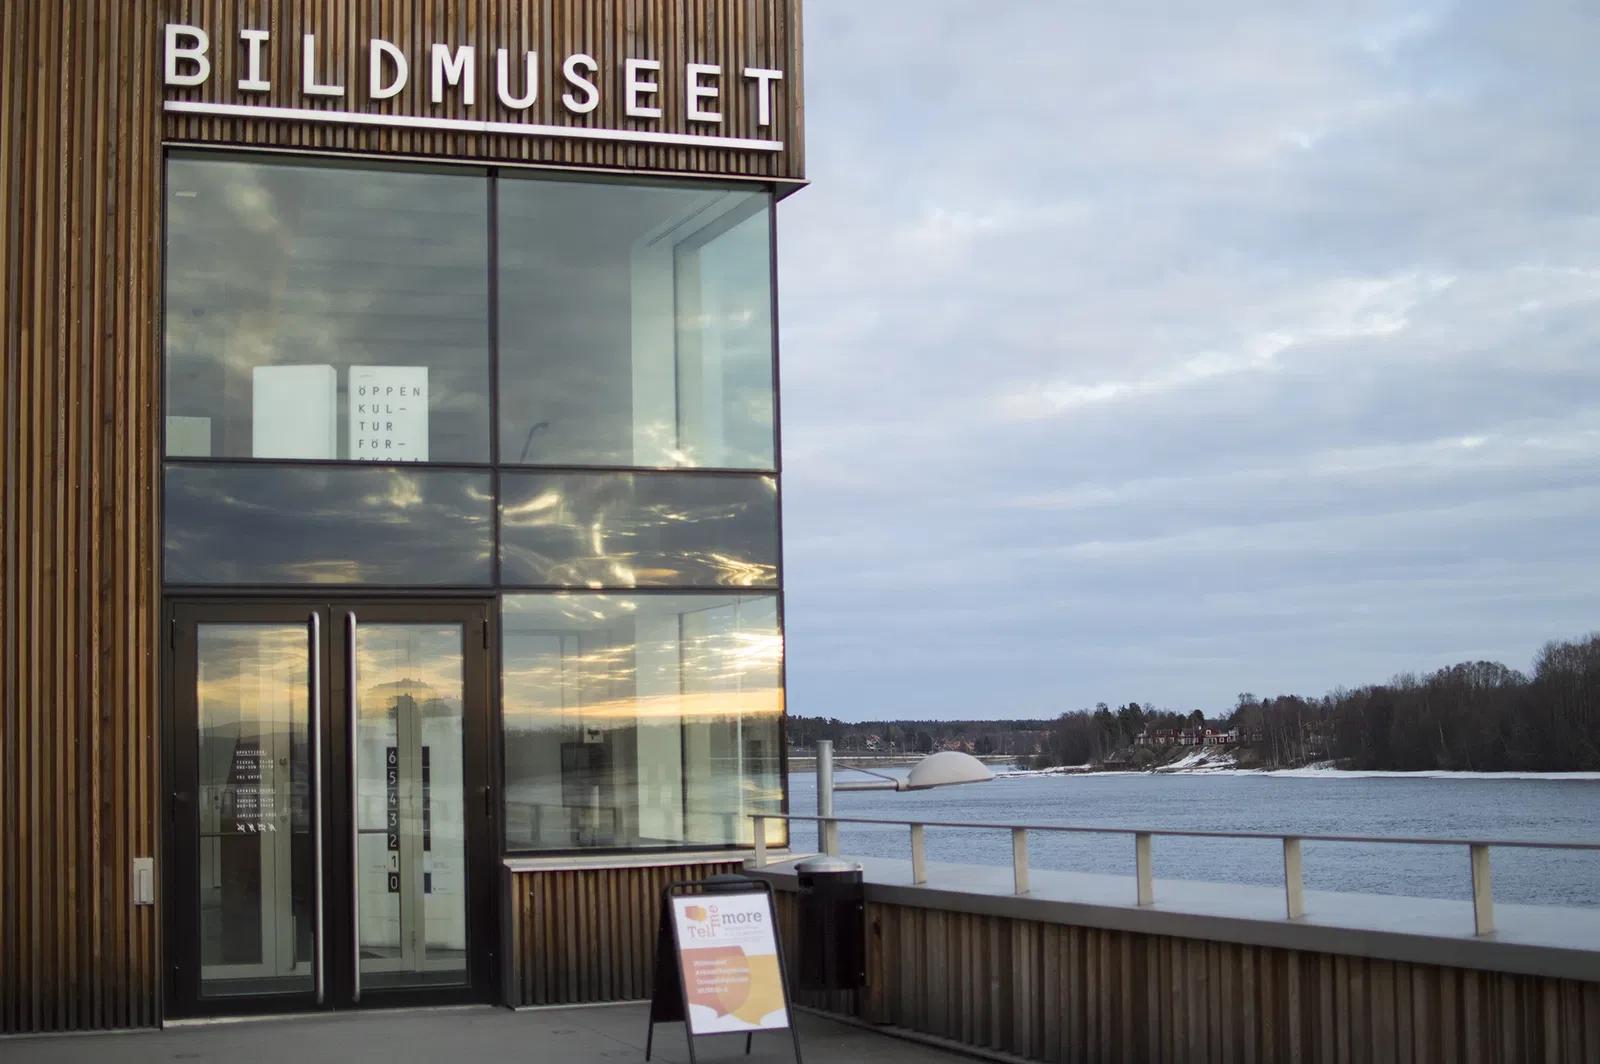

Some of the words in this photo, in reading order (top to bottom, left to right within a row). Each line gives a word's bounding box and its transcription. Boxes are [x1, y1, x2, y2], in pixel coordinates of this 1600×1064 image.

[164, 23, 782, 126] BILDMUSEET
[358, 385, 421, 397] ÖPPEN
[359, 421, 393, 432] TUR
[388, 751, 397, 764] 6
[388, 771, 397, 785] 5
[388, 791, 397, 805] 4
[389, 812, 398, 826] 3
[389, 833, 398, 848] 2
[391, 854, 397, 868] 1
[390, 875, 398, 890] 0
[687, 923, 717, 938] Tell
[722, 911, 763, 925] more
